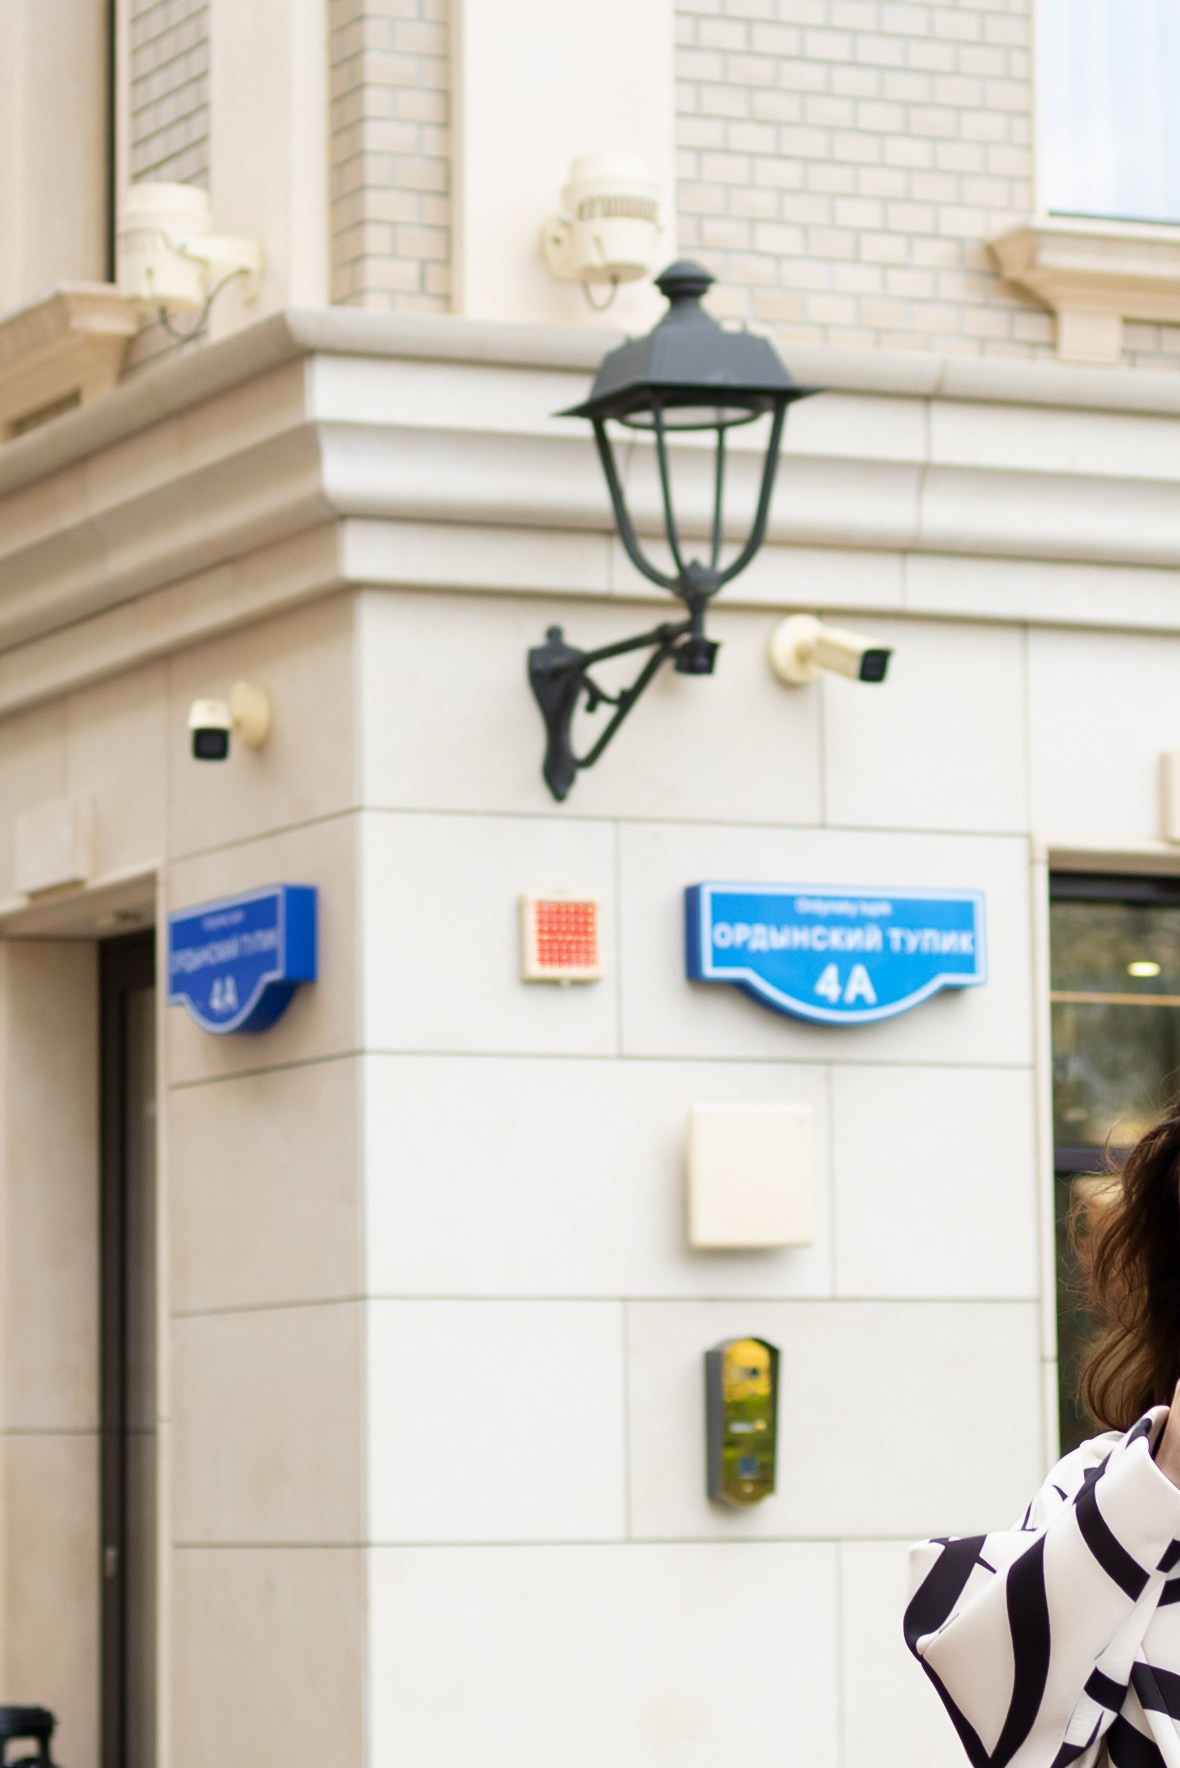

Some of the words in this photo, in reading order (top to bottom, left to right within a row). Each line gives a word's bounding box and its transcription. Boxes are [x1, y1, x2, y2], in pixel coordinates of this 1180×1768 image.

[713, 922, 882, 951] ОРДЫНСКИЙ
[888, 927, 975, 954] ТУПИК
[814, 963, 877, 1005] 4А
